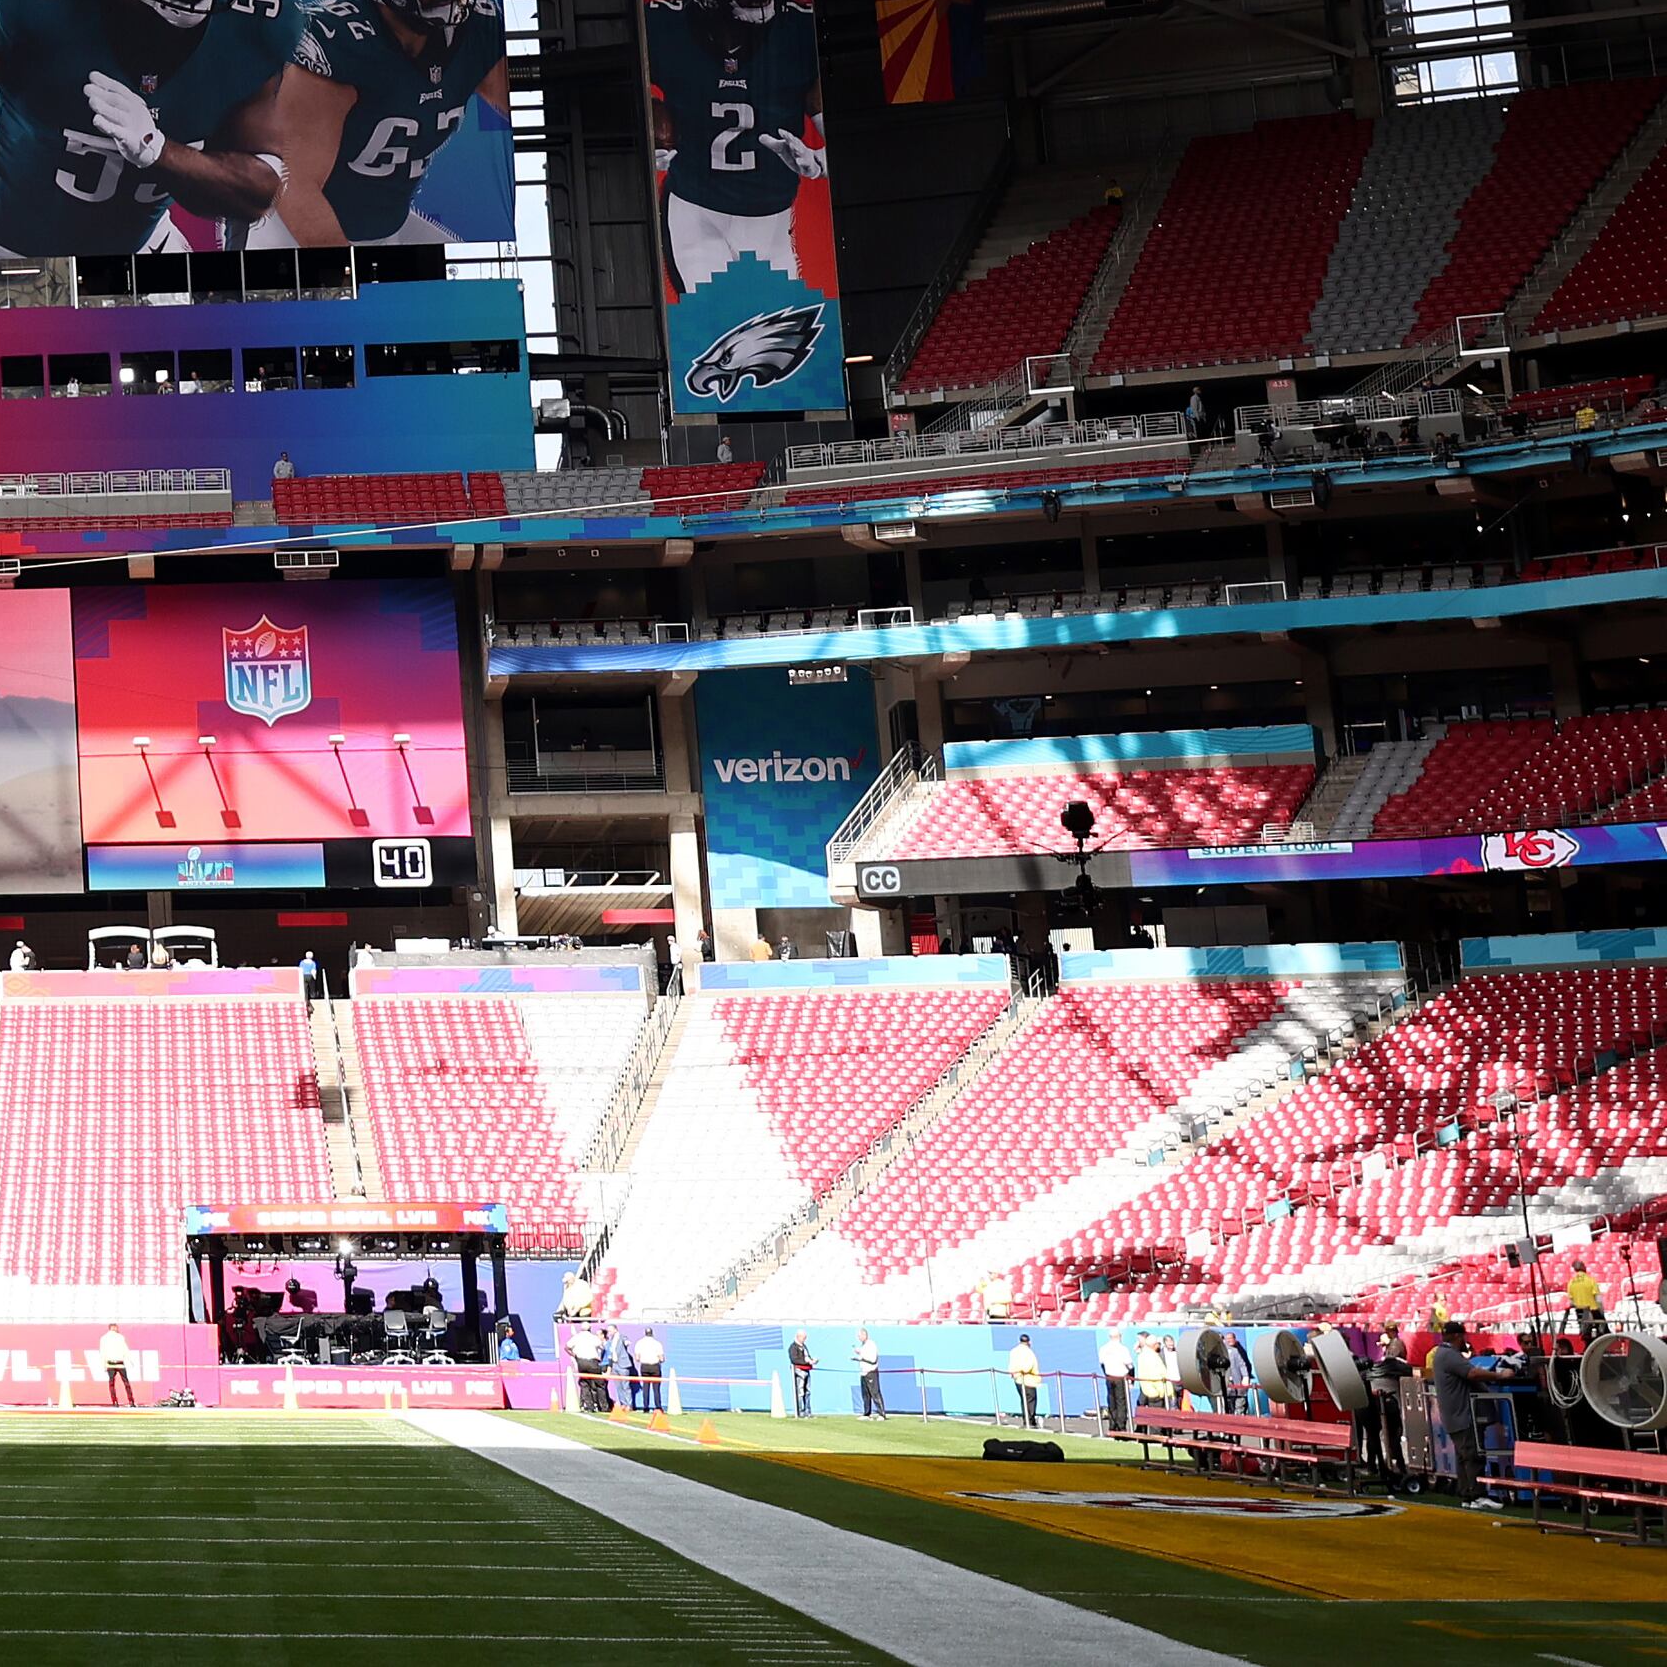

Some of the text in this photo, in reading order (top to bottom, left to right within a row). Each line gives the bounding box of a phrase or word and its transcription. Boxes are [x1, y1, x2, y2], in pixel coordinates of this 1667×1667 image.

[711, 102, 756, 171] 2
[236, 664, 301, 706] NFL
[714, 751, 850, 782] verizon
[383, 848, 423, 876] 40
[865, 870, 897, 888] CC
